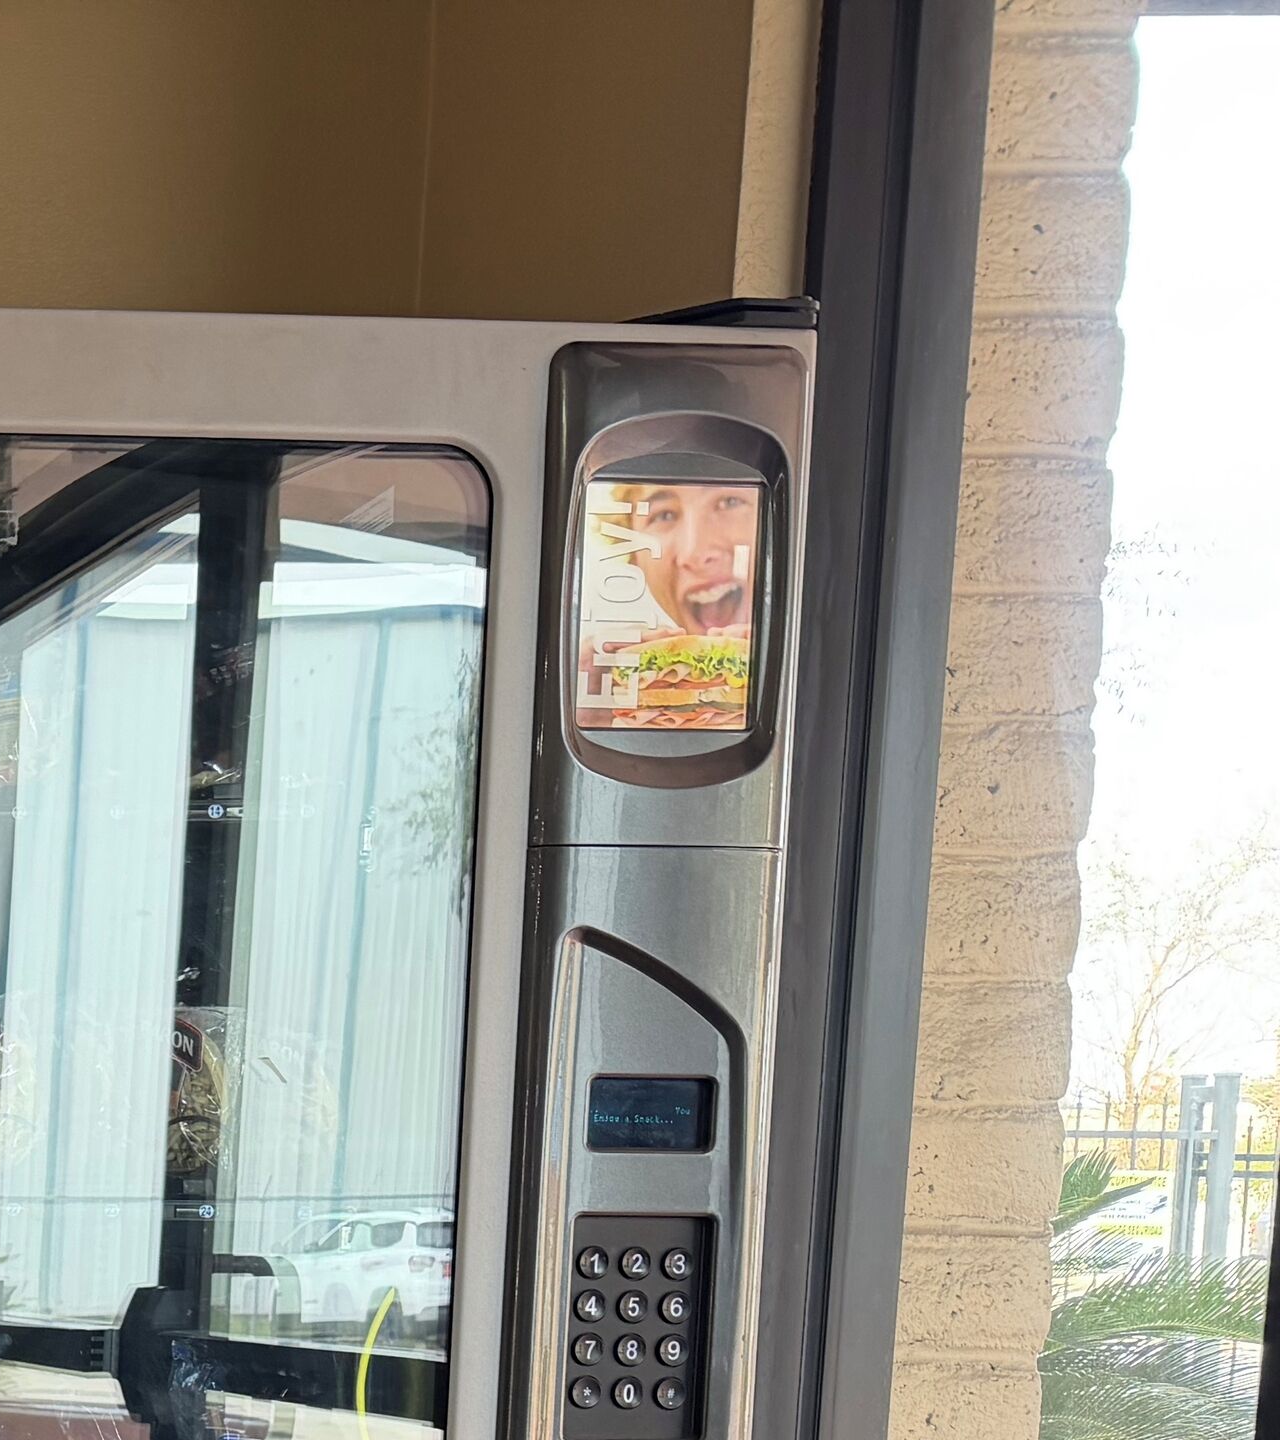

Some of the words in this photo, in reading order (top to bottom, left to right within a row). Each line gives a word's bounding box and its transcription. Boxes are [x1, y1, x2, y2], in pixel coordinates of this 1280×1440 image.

[576, 500, 662, 709] Enjoy!
[200, 1206, 213, 1217] 24
[590, 1254, 600, 1274] 1
[631, 1254, 643, 1273] 2
[672, 1254, 686, 1274] 3
[584, 1296, 597, 1316] 4
[628, 1298, 640, 1317] 5
[670, 1298, 683, 1317] 6
[585, 1340, 597, 1360] 7
[626, 1340, 638, 1360] 8
[667, 1341, 681, 1360] 9
[623, 1384, 635, 1403] 0
